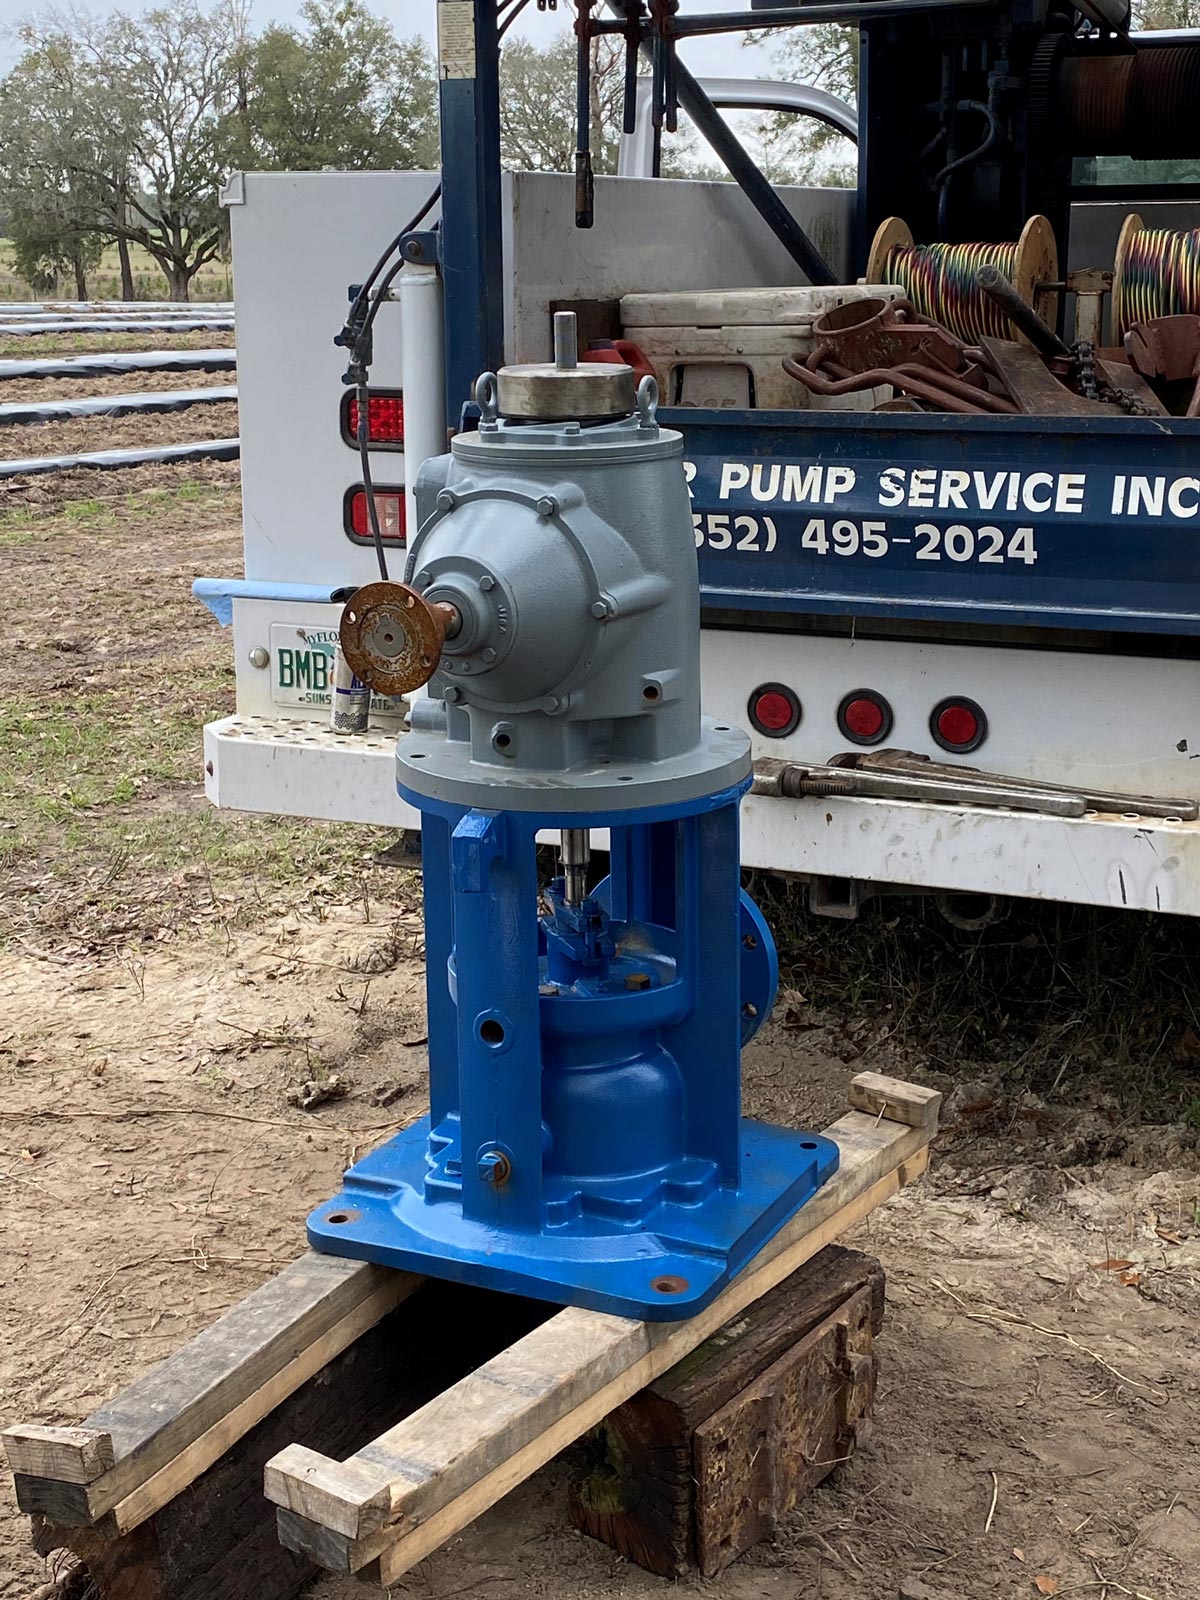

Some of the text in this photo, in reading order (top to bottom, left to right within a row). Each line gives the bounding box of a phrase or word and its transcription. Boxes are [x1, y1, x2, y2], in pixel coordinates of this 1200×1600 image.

[719, 463, 856, 503] PUMP
[878, 467, 1087, 513] SERVICE
[1111, 475, 1200, 518] INC
[801, 518, 1038, 564] 495-2024
